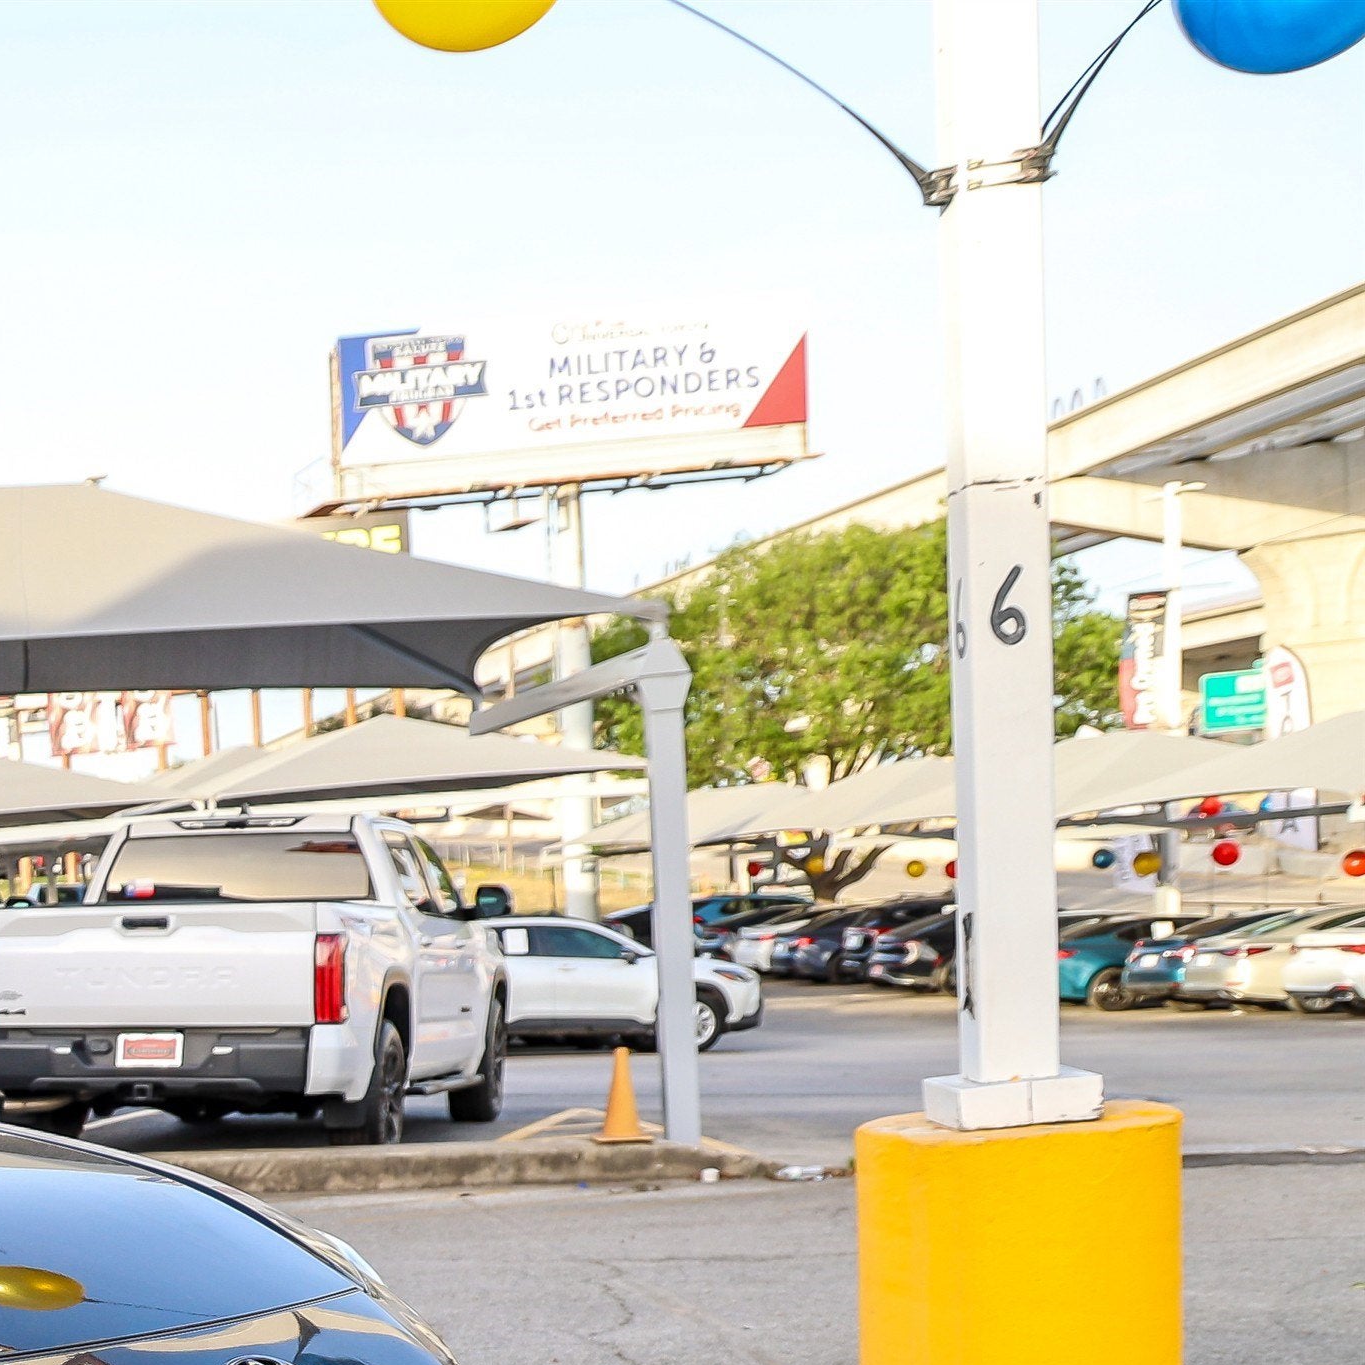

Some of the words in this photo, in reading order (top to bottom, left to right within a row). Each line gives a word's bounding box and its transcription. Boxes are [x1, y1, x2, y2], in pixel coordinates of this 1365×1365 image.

[361, 362, 483, 397] MILITARY
[549, 344, 687, 378] MILITARY
[508, 389, 547, 411] 1st
[558, 366, 760, 406] RESPONDERS
[991, 564, 1026, 646] 6
